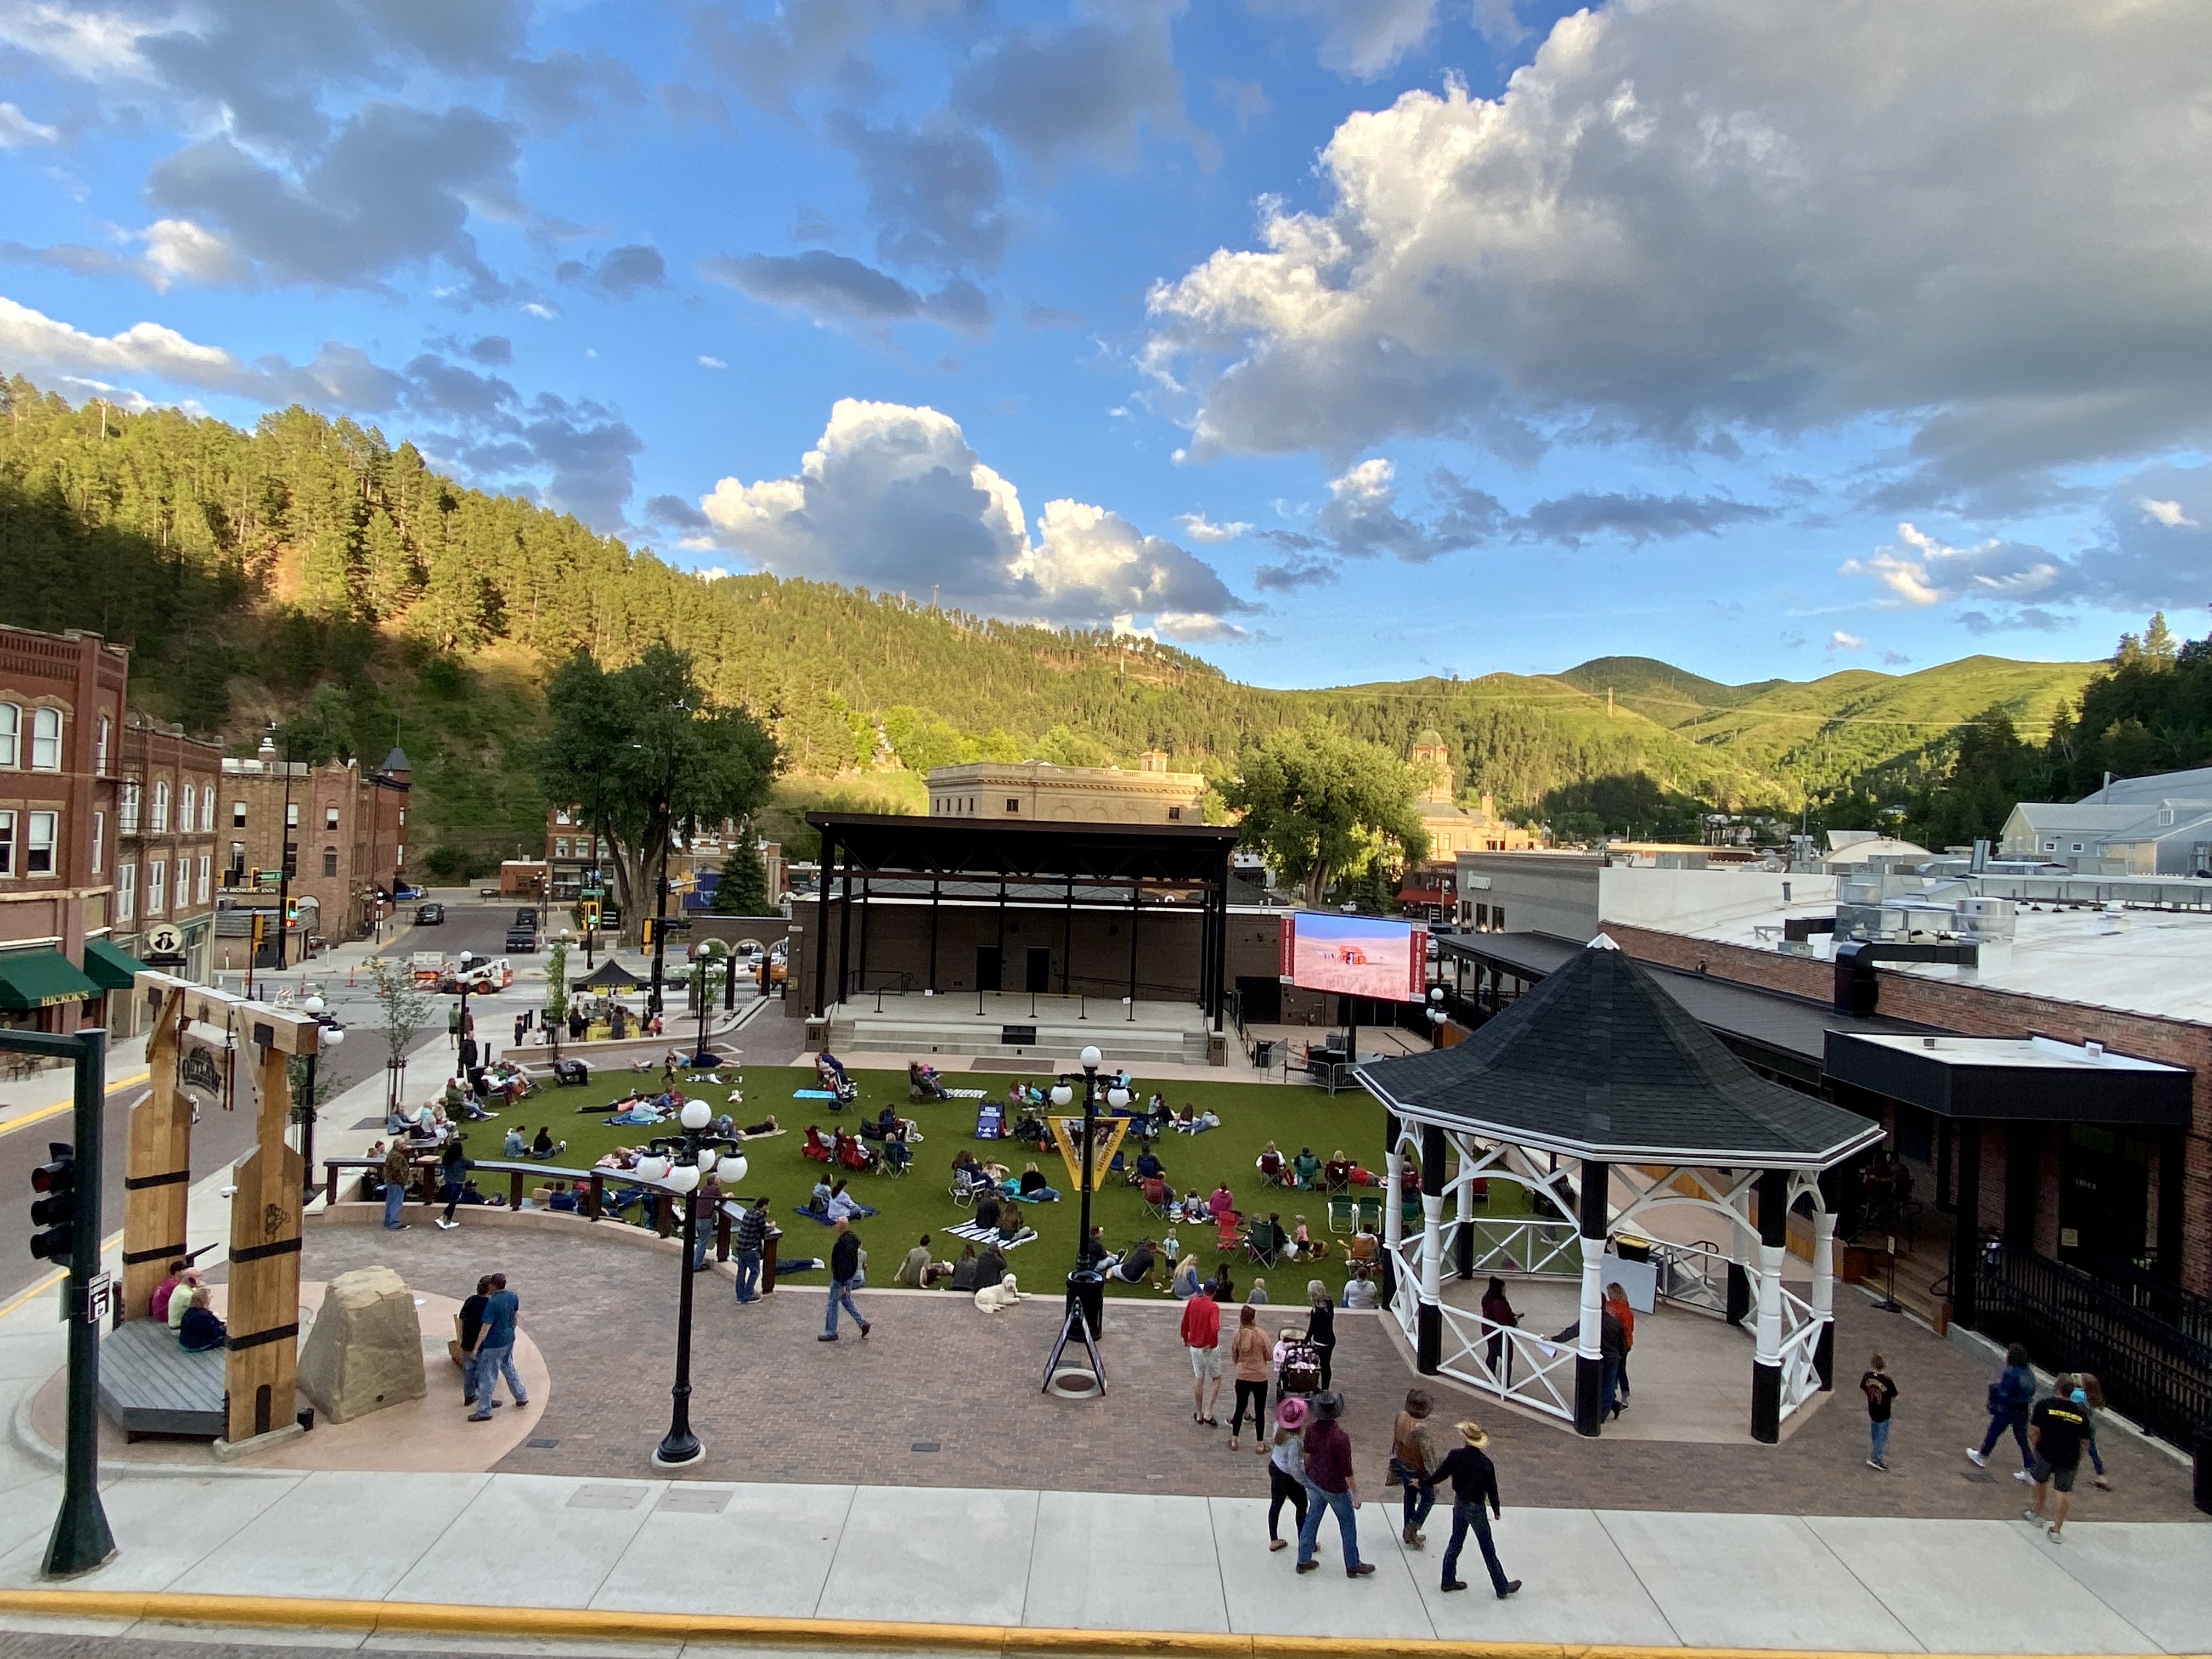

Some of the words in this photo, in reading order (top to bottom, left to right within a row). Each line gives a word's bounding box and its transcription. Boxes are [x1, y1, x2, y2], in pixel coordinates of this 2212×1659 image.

[41, 990, 89, 1007] HICKOK'S
[182, 1058, 222, 1093] OUTLAW
[1097, 1129, 1120, 1172] SHOOTOUTS
